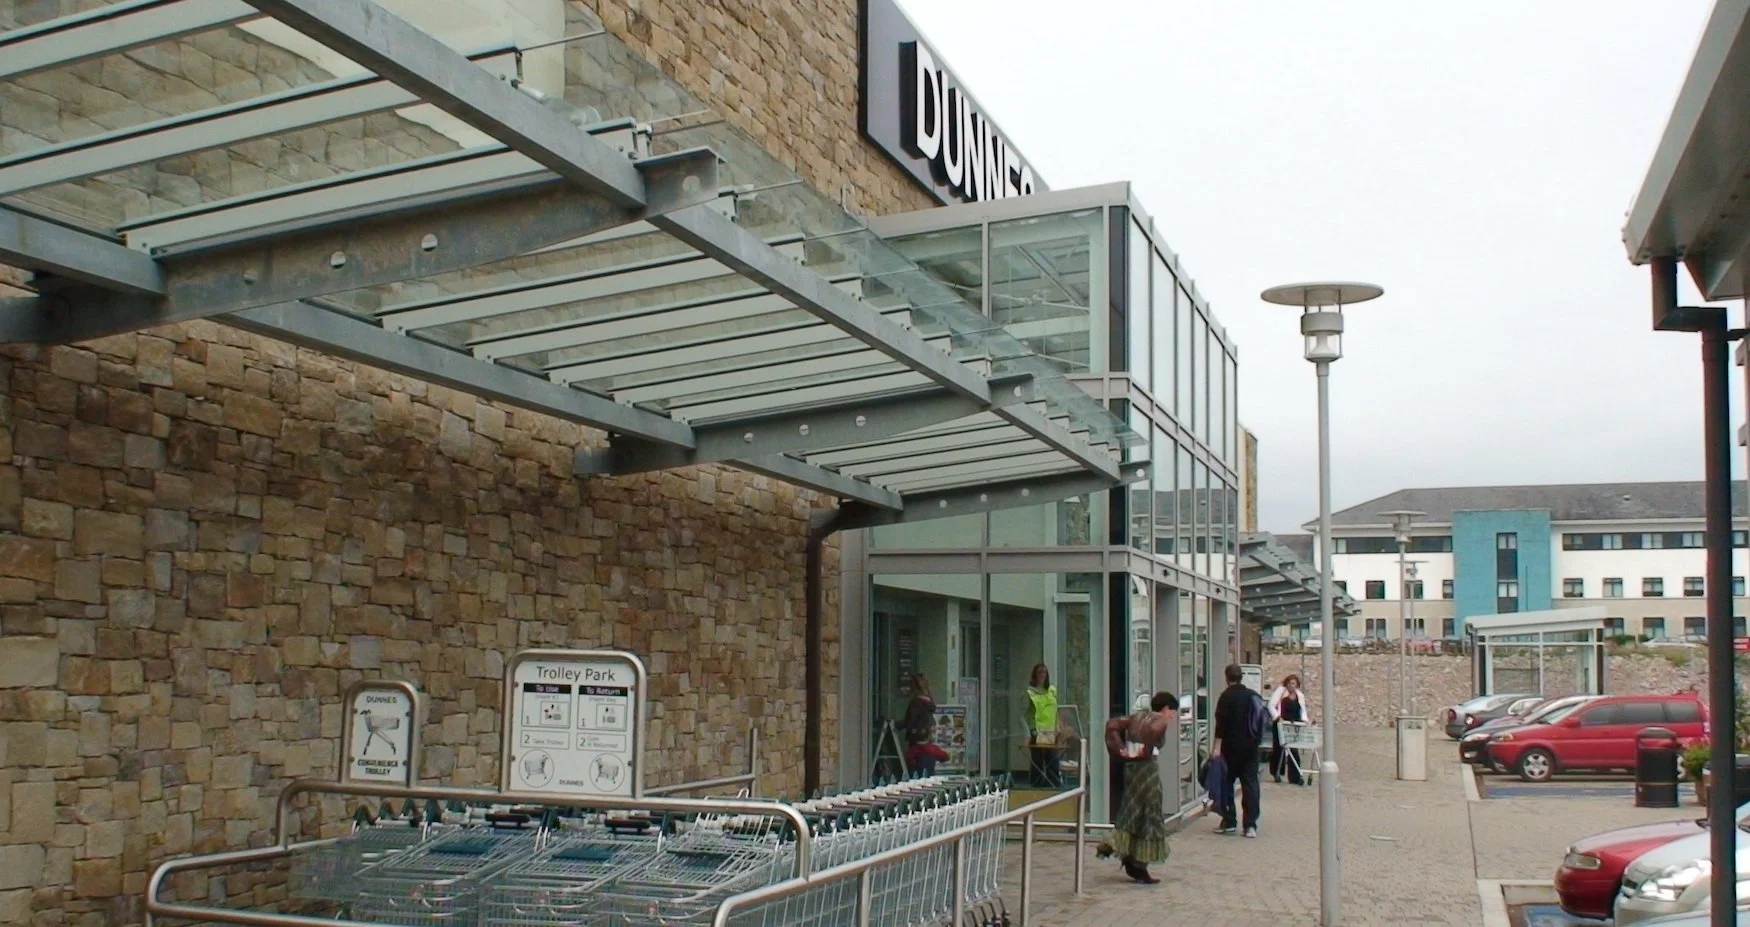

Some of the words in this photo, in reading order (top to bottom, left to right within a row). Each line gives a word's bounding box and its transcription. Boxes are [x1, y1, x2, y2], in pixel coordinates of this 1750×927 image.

[536, 666, 581, 682] Trolley
[585, 668, 615, 681] Park
[535, 684, 545, 692] To
[596, 688, 621, 696] Return
[366, 695, 398, 704] DUNNES
[524, 734, 530, 744] 2
[580, 738, 586, 748] 2
